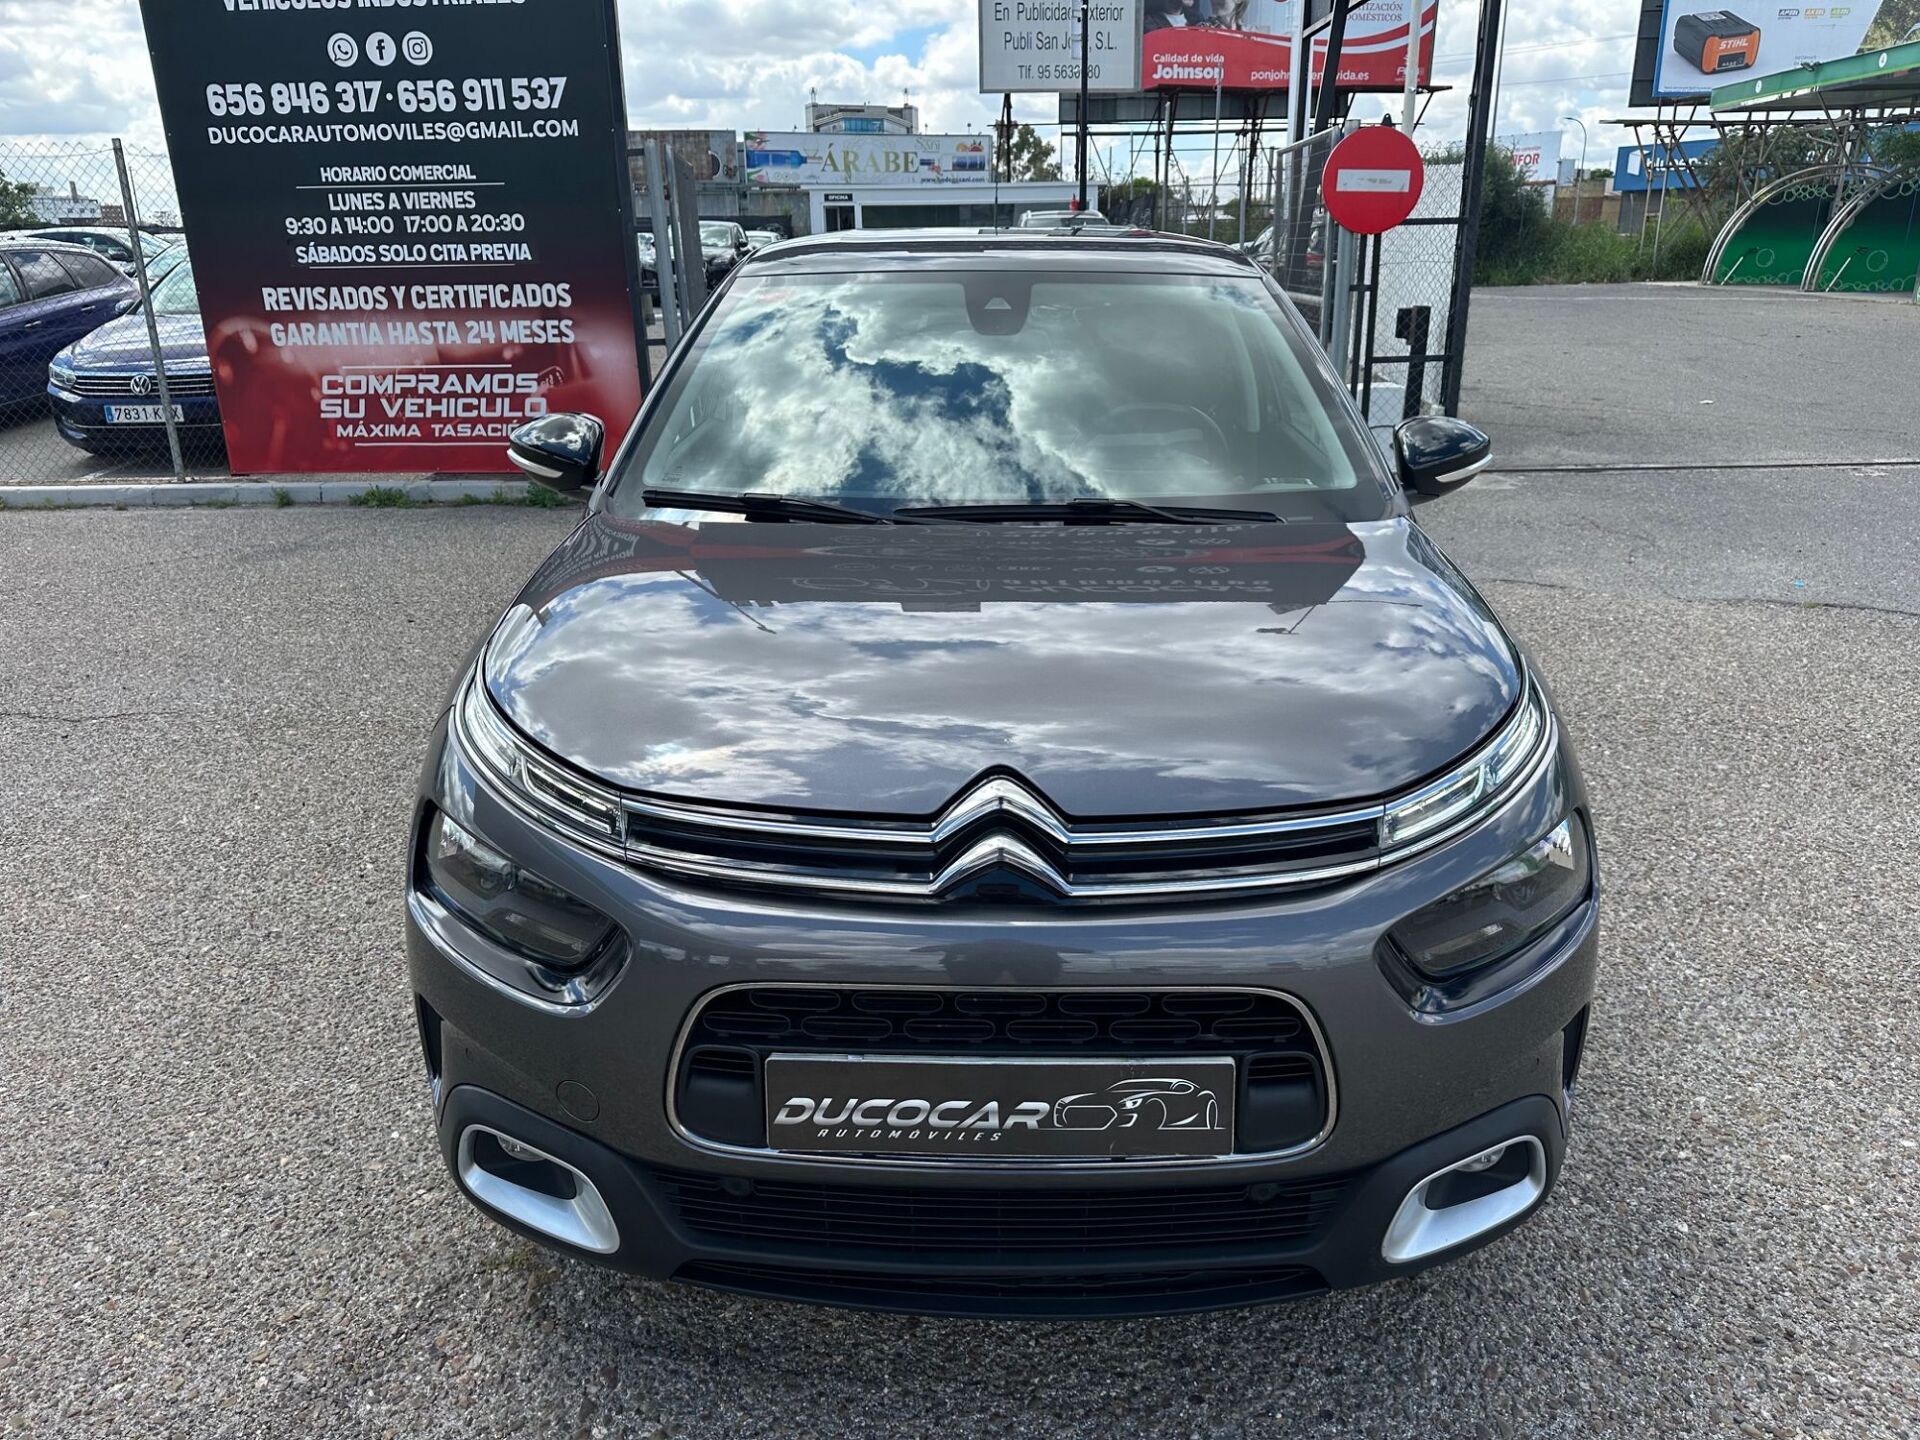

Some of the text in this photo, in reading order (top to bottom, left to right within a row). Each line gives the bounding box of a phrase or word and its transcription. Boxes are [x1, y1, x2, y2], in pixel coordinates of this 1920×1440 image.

[994, 3, 1010, 21] En
[1089, 3, 1124, 21] xterior
[1004, 31, 1032, 50] Publi
[1036, 31, 1058, 50] San
[1095, 31, 1118, 50] S.L.
[1719, 38, 1749, 50] STIHL
[1153, 53, 1225, 63] Calidad de vida
[1037, 65, 1051, 79] 95
[1152, 64, 1224, 79] Johnson
[206, 83, 265, 116] 656
[270, 81, 330, 115] 846
[462, 78, 506, 112] 911
[511, 76, 567, 111] 537
[207, 119, 579, 145] DUCOCARAUTOMOVILES@GMAIL.COM
[821, 143, 920, 174] ÁRABE
[320, 164, 476, 182] HORARIO COMERCIAL
[328, 190, 476, 211] LUNES A VIERNES
[285, 213, 525, 235] 9:30 A 14:00 17:00 A 20:30
[296, 241, 531, 263] SÁBADOS SOLO CITA PREVIA
[262, 283, 572, 311] REVISADOS Y CERTIFICADOS
[270, 319, 575, 347] GARANTIA HASTA 24 MESES
[321, 373, 539, 395] COMPRAMOS
[114, 407, 181, 421] 7831 KX
[320, 396, 547, 419] SU VEHICULO
[336, 421, 421, 438] MÁXIMA
[774, 1096, 1050, 1130] DUCOCAR
[817, 1127, 1002, 1142] AUTOMÓVILES
